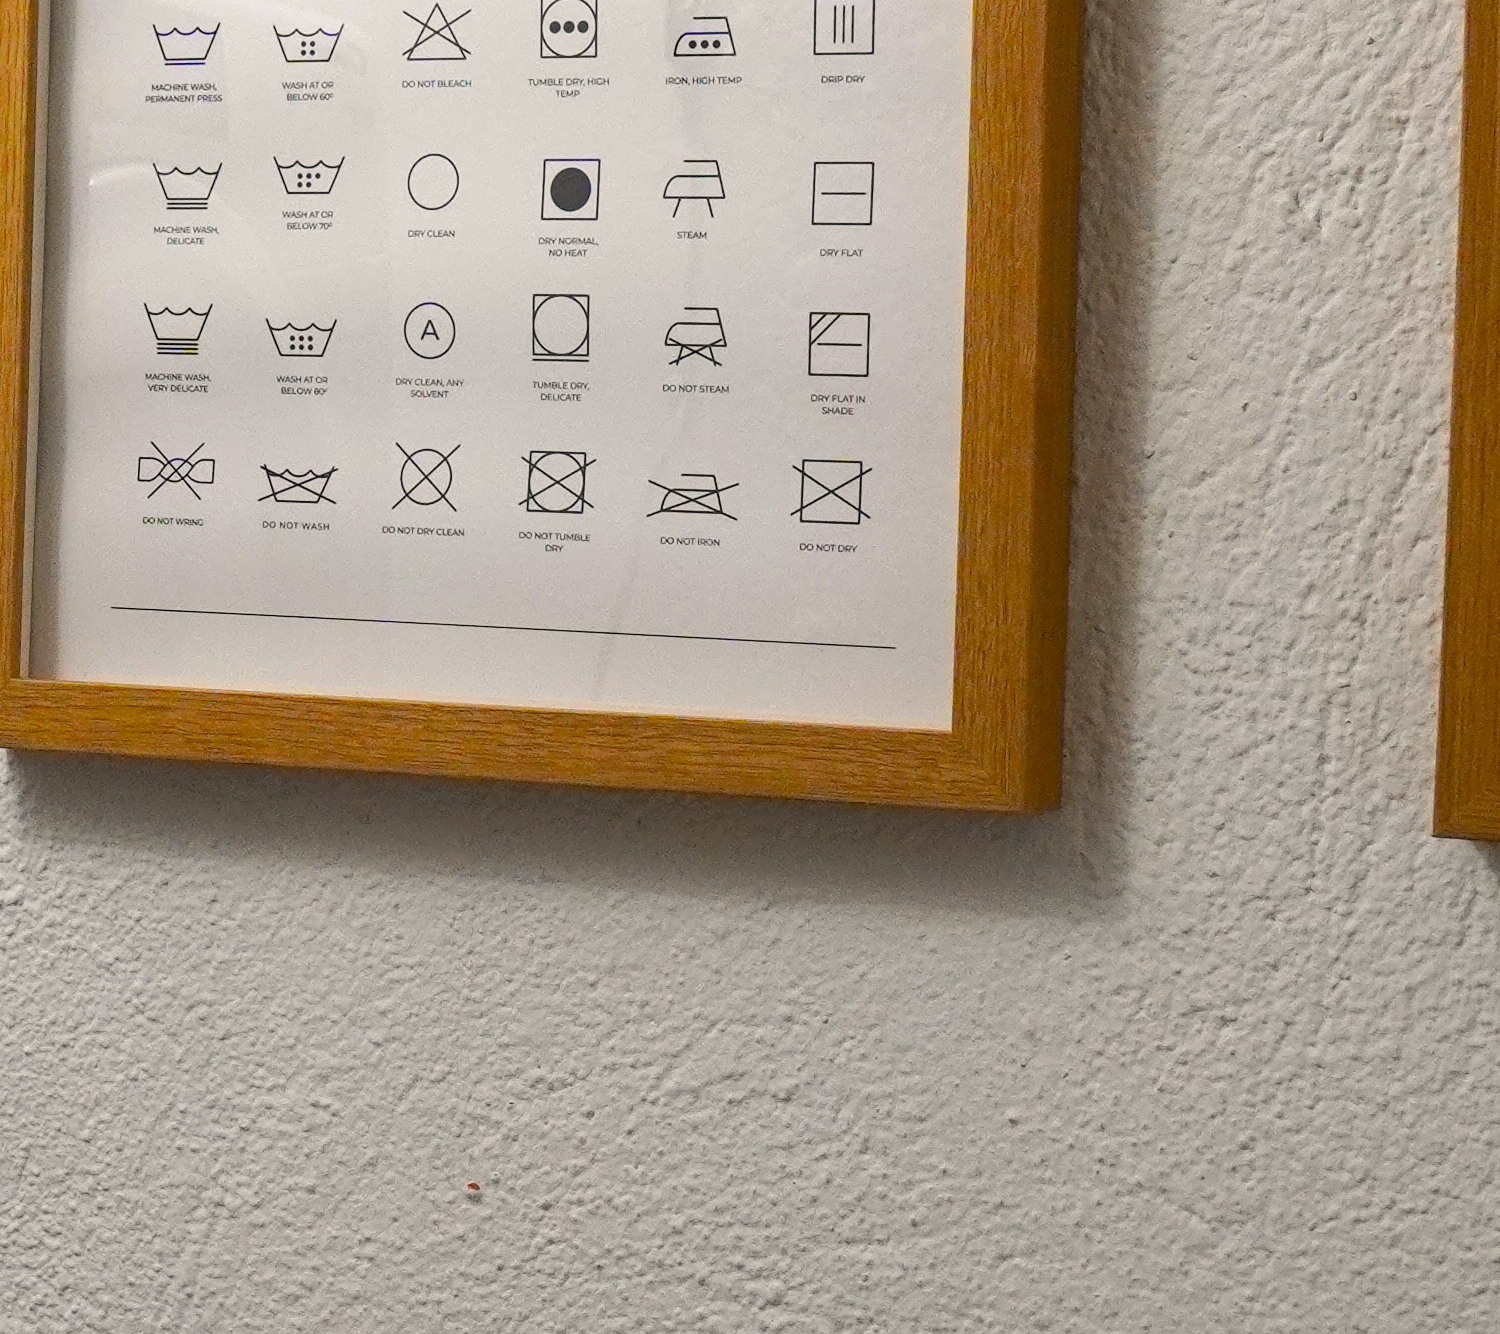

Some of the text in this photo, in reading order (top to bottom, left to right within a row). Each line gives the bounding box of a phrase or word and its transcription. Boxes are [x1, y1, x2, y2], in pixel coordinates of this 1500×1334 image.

[820, 74, 865, 83] DRIP DRY
[151, 83, 188, 91] MACHINE
[401, 79, 471, 88] DO NOT BLEACH
[145, 94, 223, 103] PERMANENT PRESS
[407, 229, 455, 238] DRY CLEAN
[676, 230, 707, 239] STEAM
[819, 248, 863, 257] DRY FLAT
[420, 319, 440, 341] A
[262, 520, 329, 530] DO NOT WASH
[660, 536, 720, 546] DO NOT IRON
